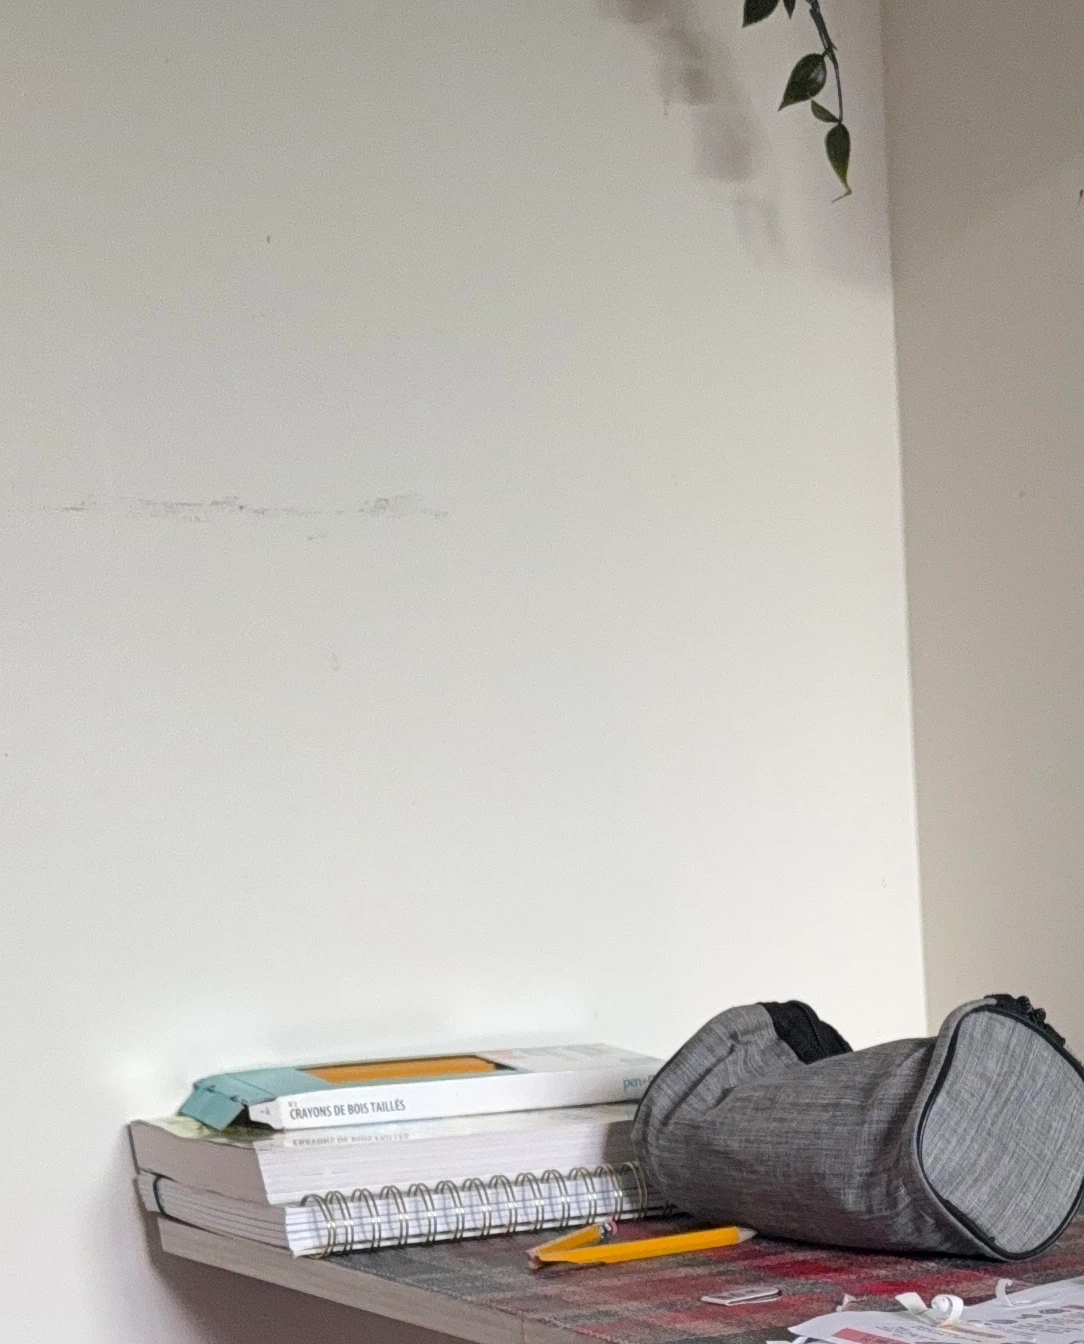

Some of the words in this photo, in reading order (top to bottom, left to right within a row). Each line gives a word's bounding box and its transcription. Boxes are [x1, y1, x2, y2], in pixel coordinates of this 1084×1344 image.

[290, 1105, 332, 1120] CRAYONS
[333, 1104, 346, 1116] DE
[347, 1102, 370, 1115] BOIS
[369, 1098, 406, 1113] TAILLÉS
